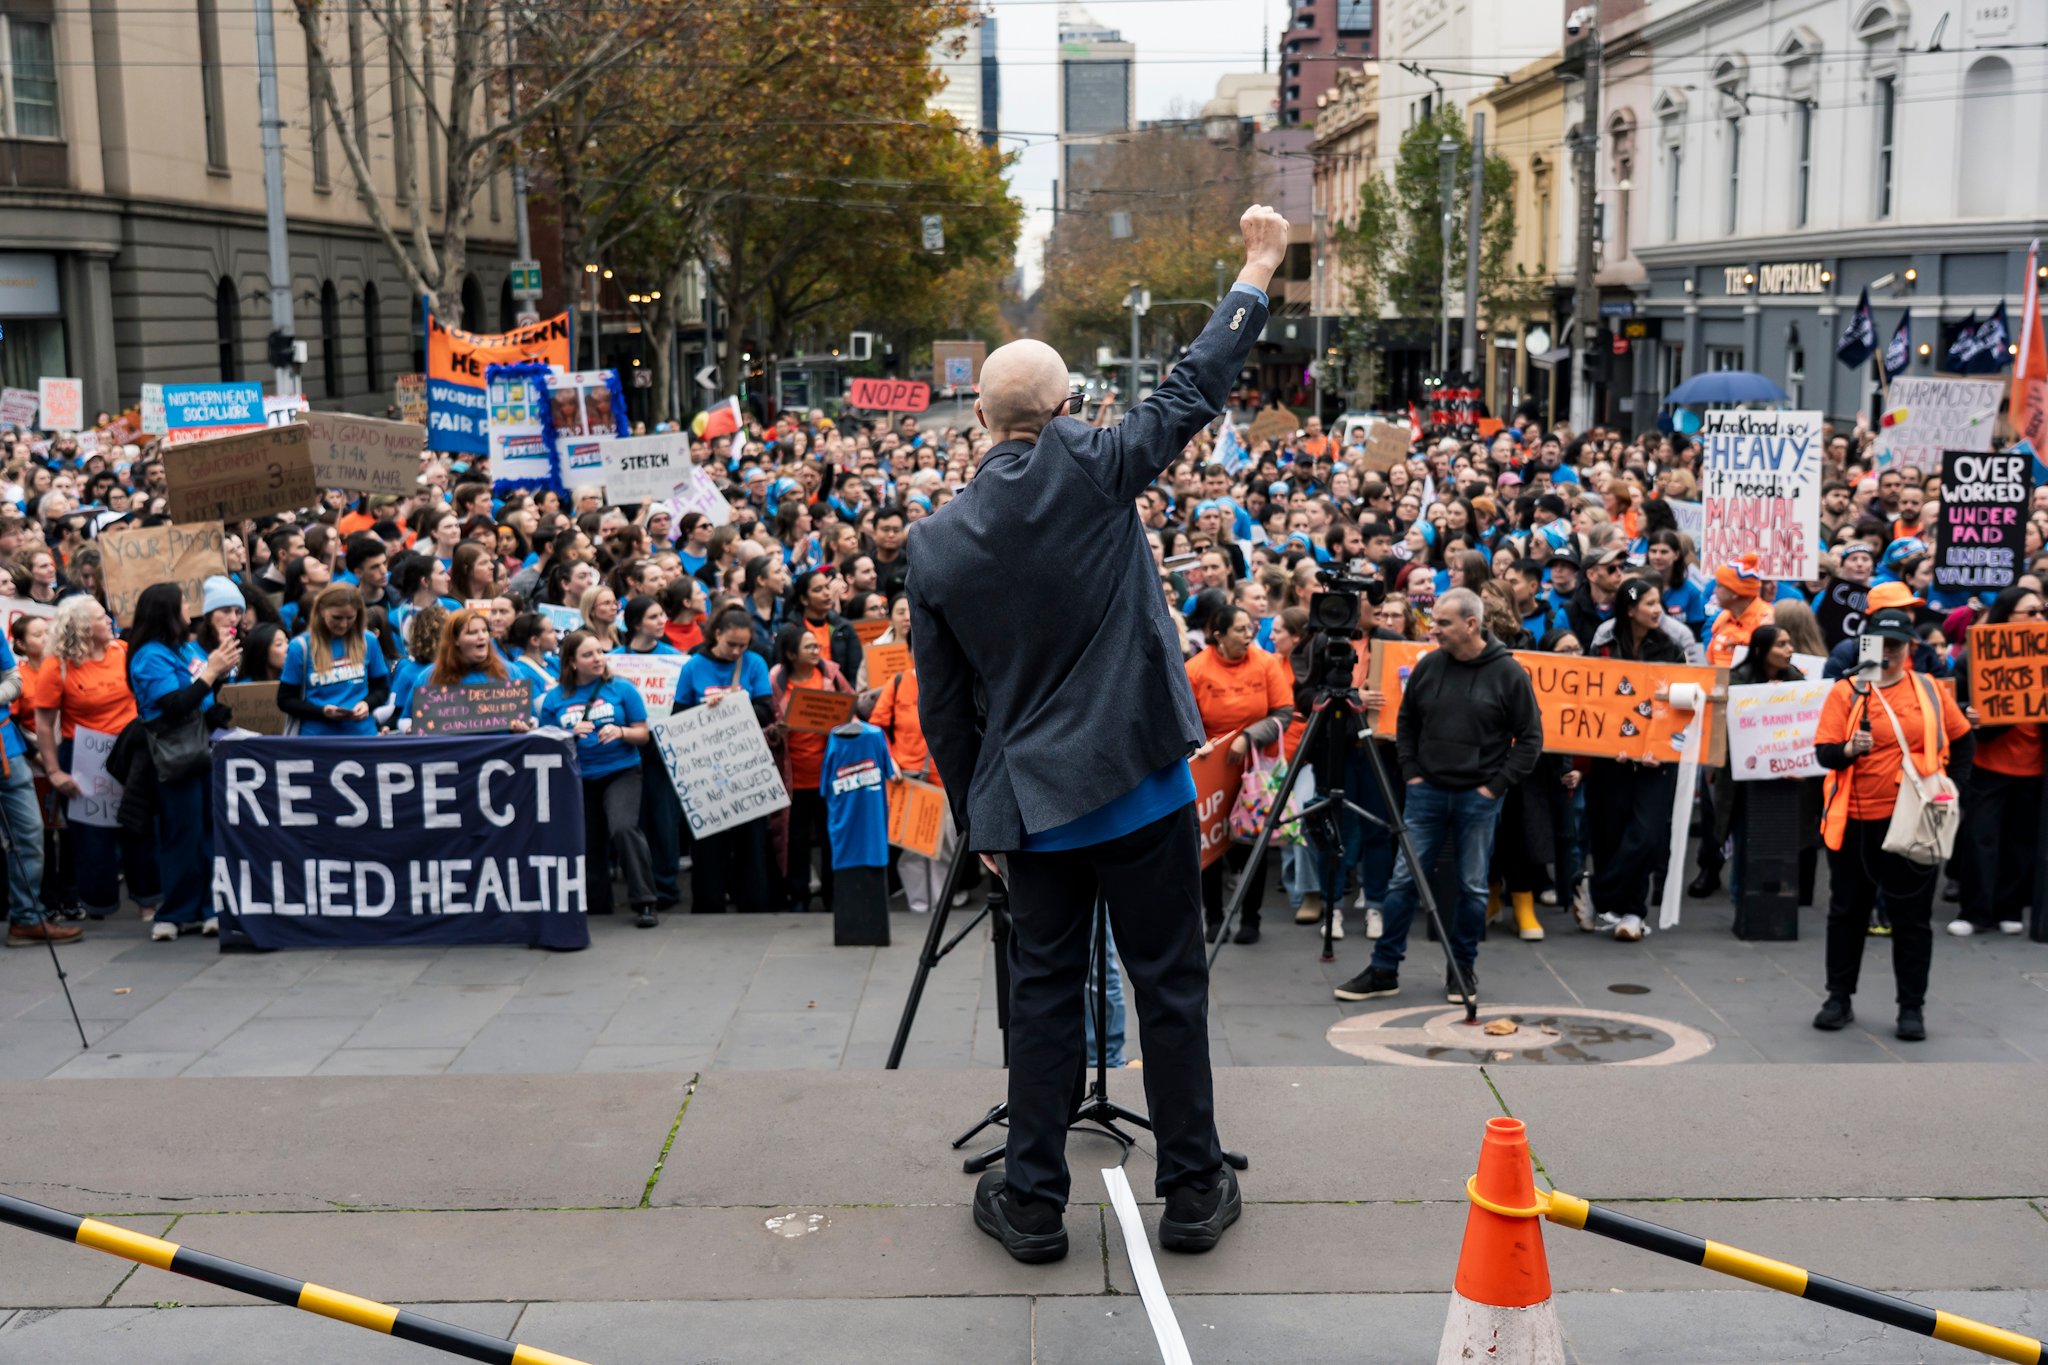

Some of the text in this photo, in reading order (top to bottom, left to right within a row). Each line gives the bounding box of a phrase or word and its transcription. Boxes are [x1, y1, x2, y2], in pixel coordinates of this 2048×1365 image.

[1724, 262, 1824, 294] THE IMPERIAL
[168, 388, 259, 406] NORTHERN HEALTH
[432, 387, 486, 409] WORKE
[858, 383, 924, 407] NOPE
[1892, 381, 1999, 408] PHARMACISTS
[183, 403, 250, 422] SOCIAL WORK
[430, 411, 472, 433] FAIR
[309, 423, 335, 442] EW
[338, 425, 380, 446] GRAD
[1890, 427, 1976, 445] MEDICATION
[621, 454, 669, 470] STRETCH
[1711, 436, 1809, 472] HEAVY
[337, 464, 368, 481] THAN
[1954, 456, 2025, 483] OVER
[1735, 474, 1783, 498] needs
[1792, 487, 1800, 498] a
[1941, 482, 2026, 503] WORKED
[1706, 497, 1802, 529] MANUAL
[1948, 507, 2017, 525] UNDER
[1704, 528, 1804, 553] HANDLING
[1952, 526, 2003, 543] PAID
[106, 535, 160, 567] YOUR
[1946, 546, 2014, 567] UNDER
[1976, 629, 2048, 660] HEALTHC
[645, 677, 666, 688] ARE
[427, 687, 529, 703] SAFE DECISIONS
[1982, 693, 2015, 717] THE
[438, 702, 517, 717] NEED SKILLED
[1739, 716, 1757, 729] BIG
[1762, 713, 1793, 727] BRAIN
[441, 716, 508, 731] CLINICIANS
[654, 719, 697, 742] Please
[701, 719, 754, 748] Profession
[1561, 708, 1606, 738] PAY
[667, 760, 691, 779] You
[713, 748, 727, 762] on
[728, 737, 762, 758] Daily
[1769, 752, 1817, 774] BUDGET
[677, 775, 710, 798] Seen
[724, 751, 770, 778] Essential
[706, 788, 727, 803] Not
[727, 768, 773, 795] VALUED
[225, 754, 563, 829] RESPECT
[1198, 790, 1225, 822] UP
[690, 811, 720, 830] Only
[212, 854, 588, 918] ALLIED HEALTH
